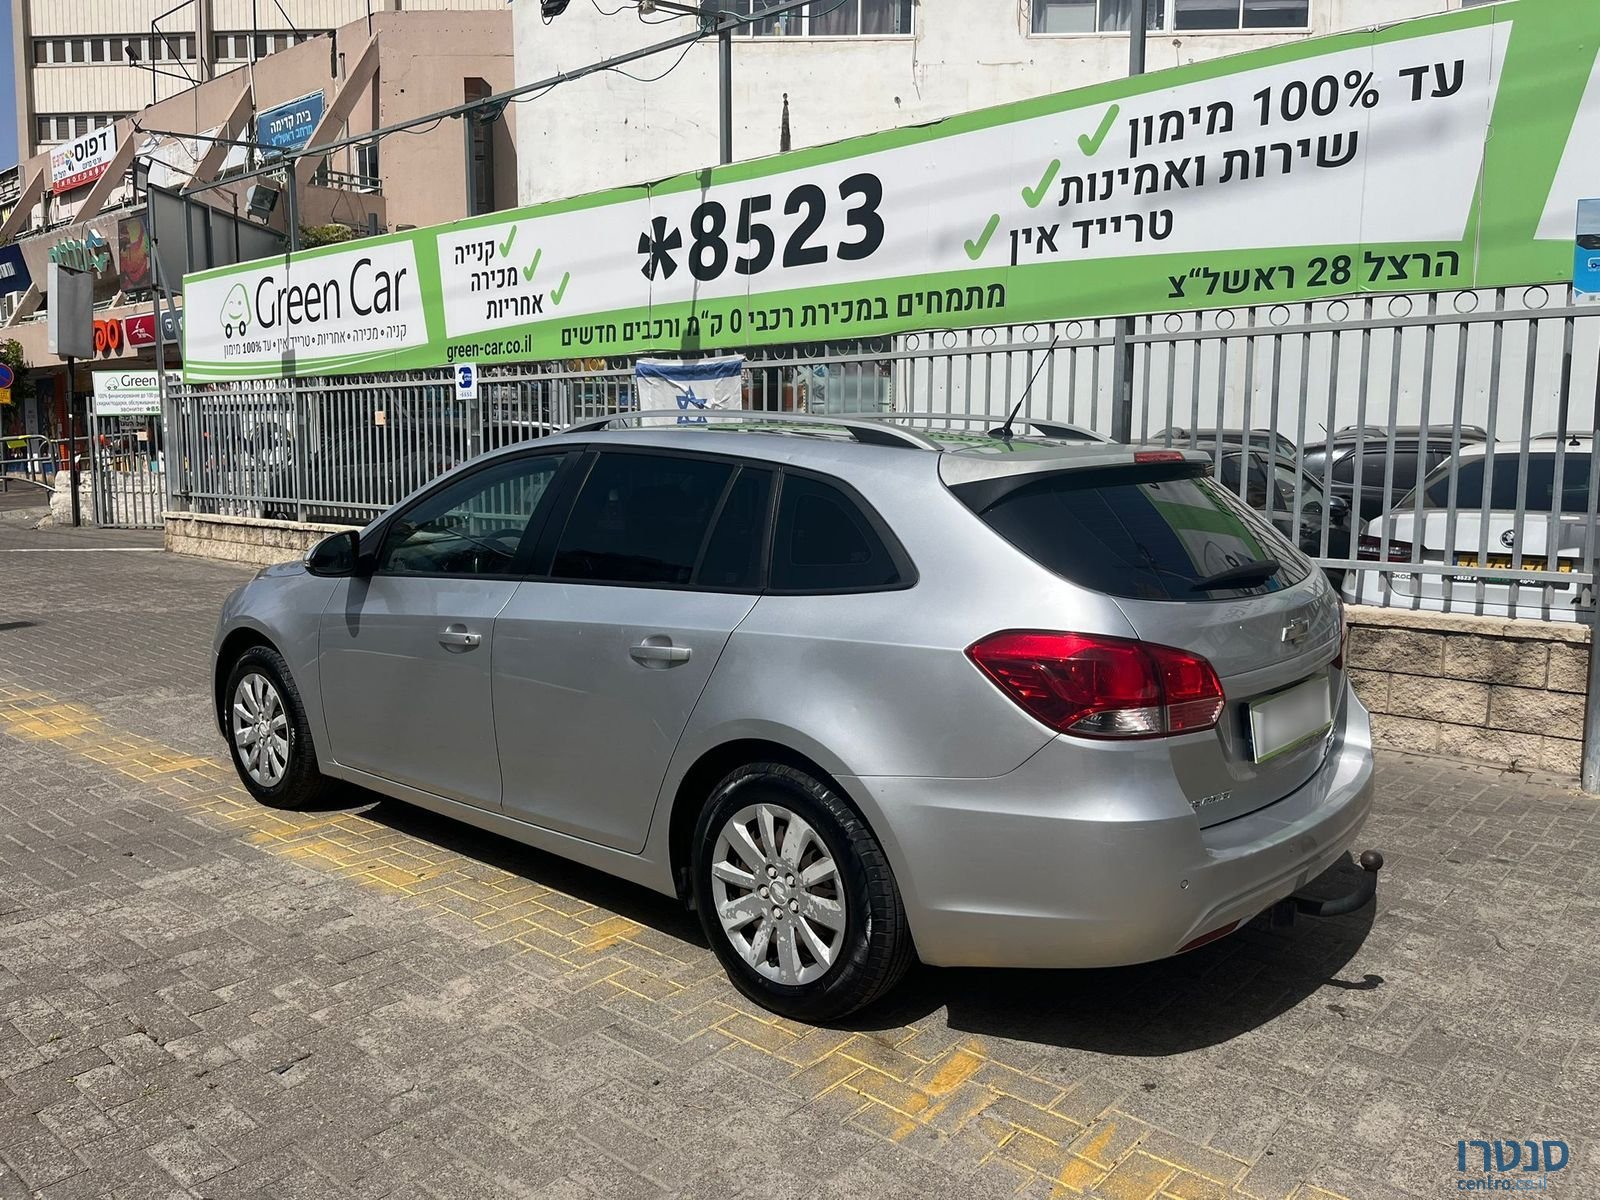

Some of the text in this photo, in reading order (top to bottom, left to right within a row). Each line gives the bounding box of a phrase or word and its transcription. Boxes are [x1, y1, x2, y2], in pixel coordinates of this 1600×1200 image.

[1129, 59, 1464, 158] עד 100% מימון
[270, 110, 311, 134] בית קדימה
[74, 132, 107, 162] דפוס
[1058, 131, 1358, 206] שירות ואמינות
[1010, 209, 1173, 266] טרייד אין
[455, 240, 495, 266] קנייה
[471, 266, 518, 292] מכירה
[1307, 255, 1351, 287] 28
[1364, 251, 1459, 282] הרצל
[255, 258, 407, 329] Green Car
[897, 283, 1005, 317] מתמחים
[486, 294, 544, 319] אחריות
[749, 307, 793, 331] רכבי
[800, 296, 888, 327] במכירת
[387, 324, 407, 341] קניה
[623, 318, 680, 342] ורכבים
[730, 308, 742, 333] 0
[262, 341, 272, 351] עד
[290, 335, 310, 348] טרייד
[317, 331, 346, 346] אחריות
[353, 327, 379, 342] מכירה
[561, 324, 617, 346] חדשים
[224, 343, 241, 359] מימון
[242, 342, 262, 354] 100%
[447, 334, 532, 362] green-car.co.il
[121, 375, 156, 387] Green
